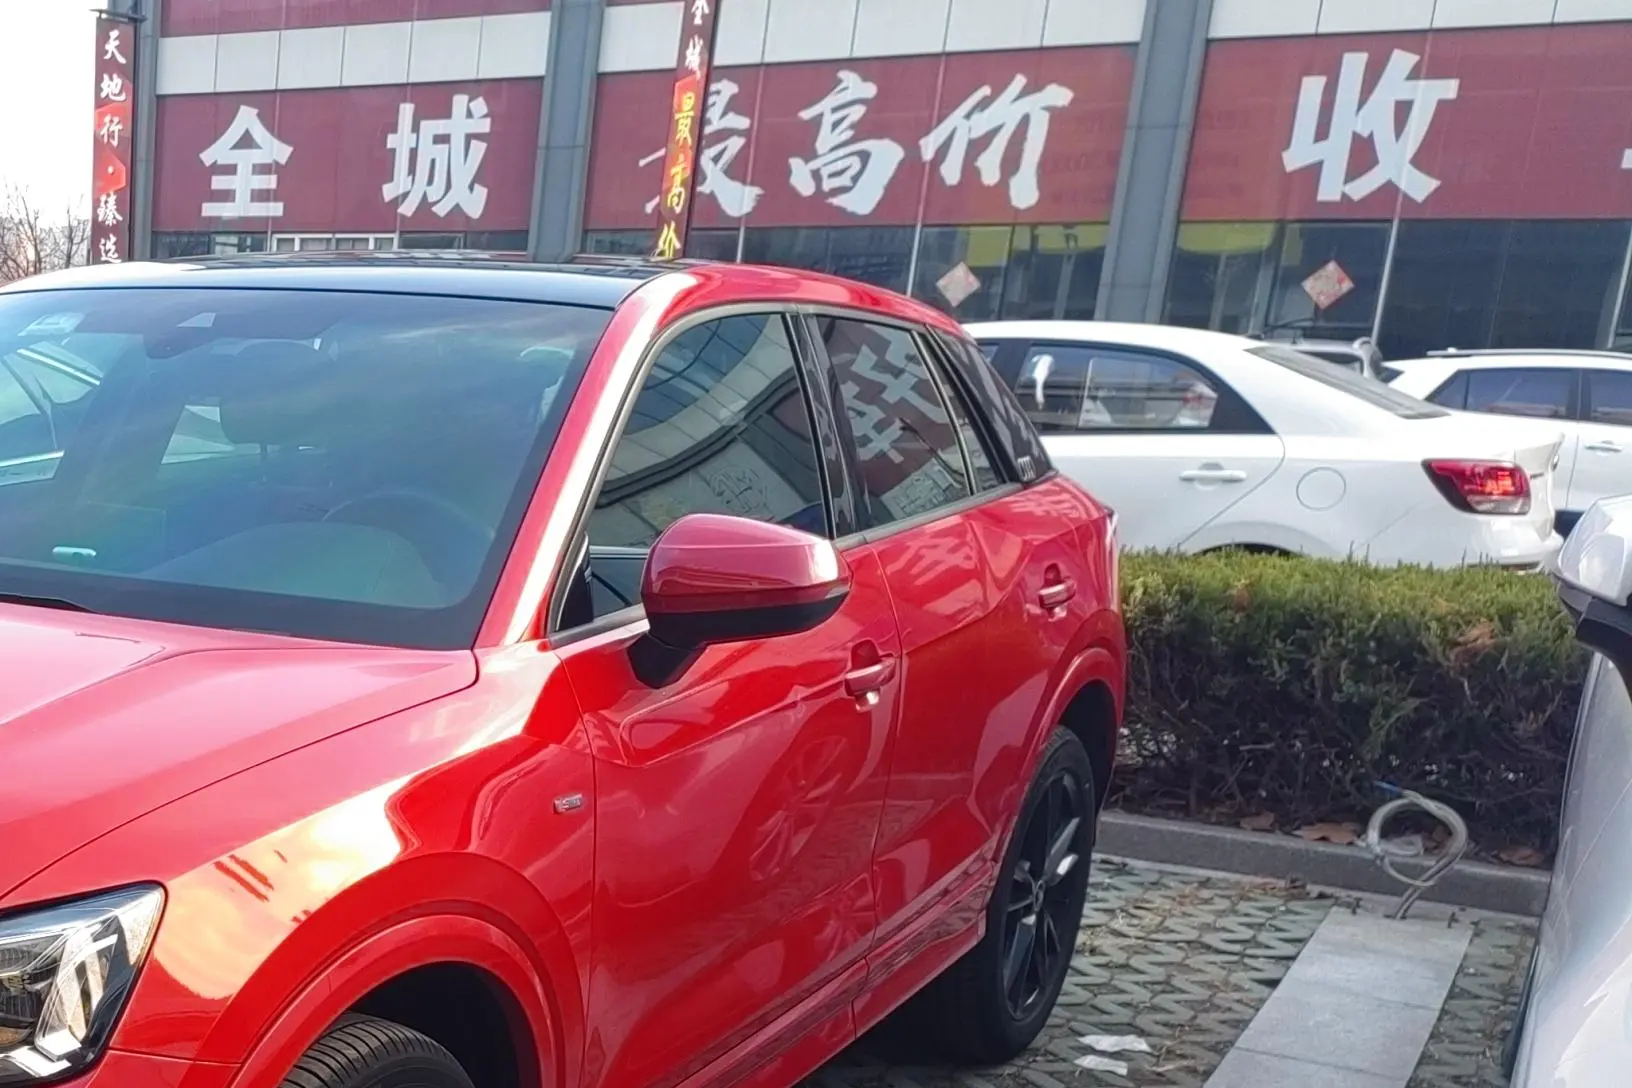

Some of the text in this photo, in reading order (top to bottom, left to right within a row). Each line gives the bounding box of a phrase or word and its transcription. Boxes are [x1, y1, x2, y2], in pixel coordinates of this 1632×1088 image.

[199, 94, 491, 220] 全城
[638, 70, 1074, 218] 最高价
[651, 0, 710, 259] 全城最高价
